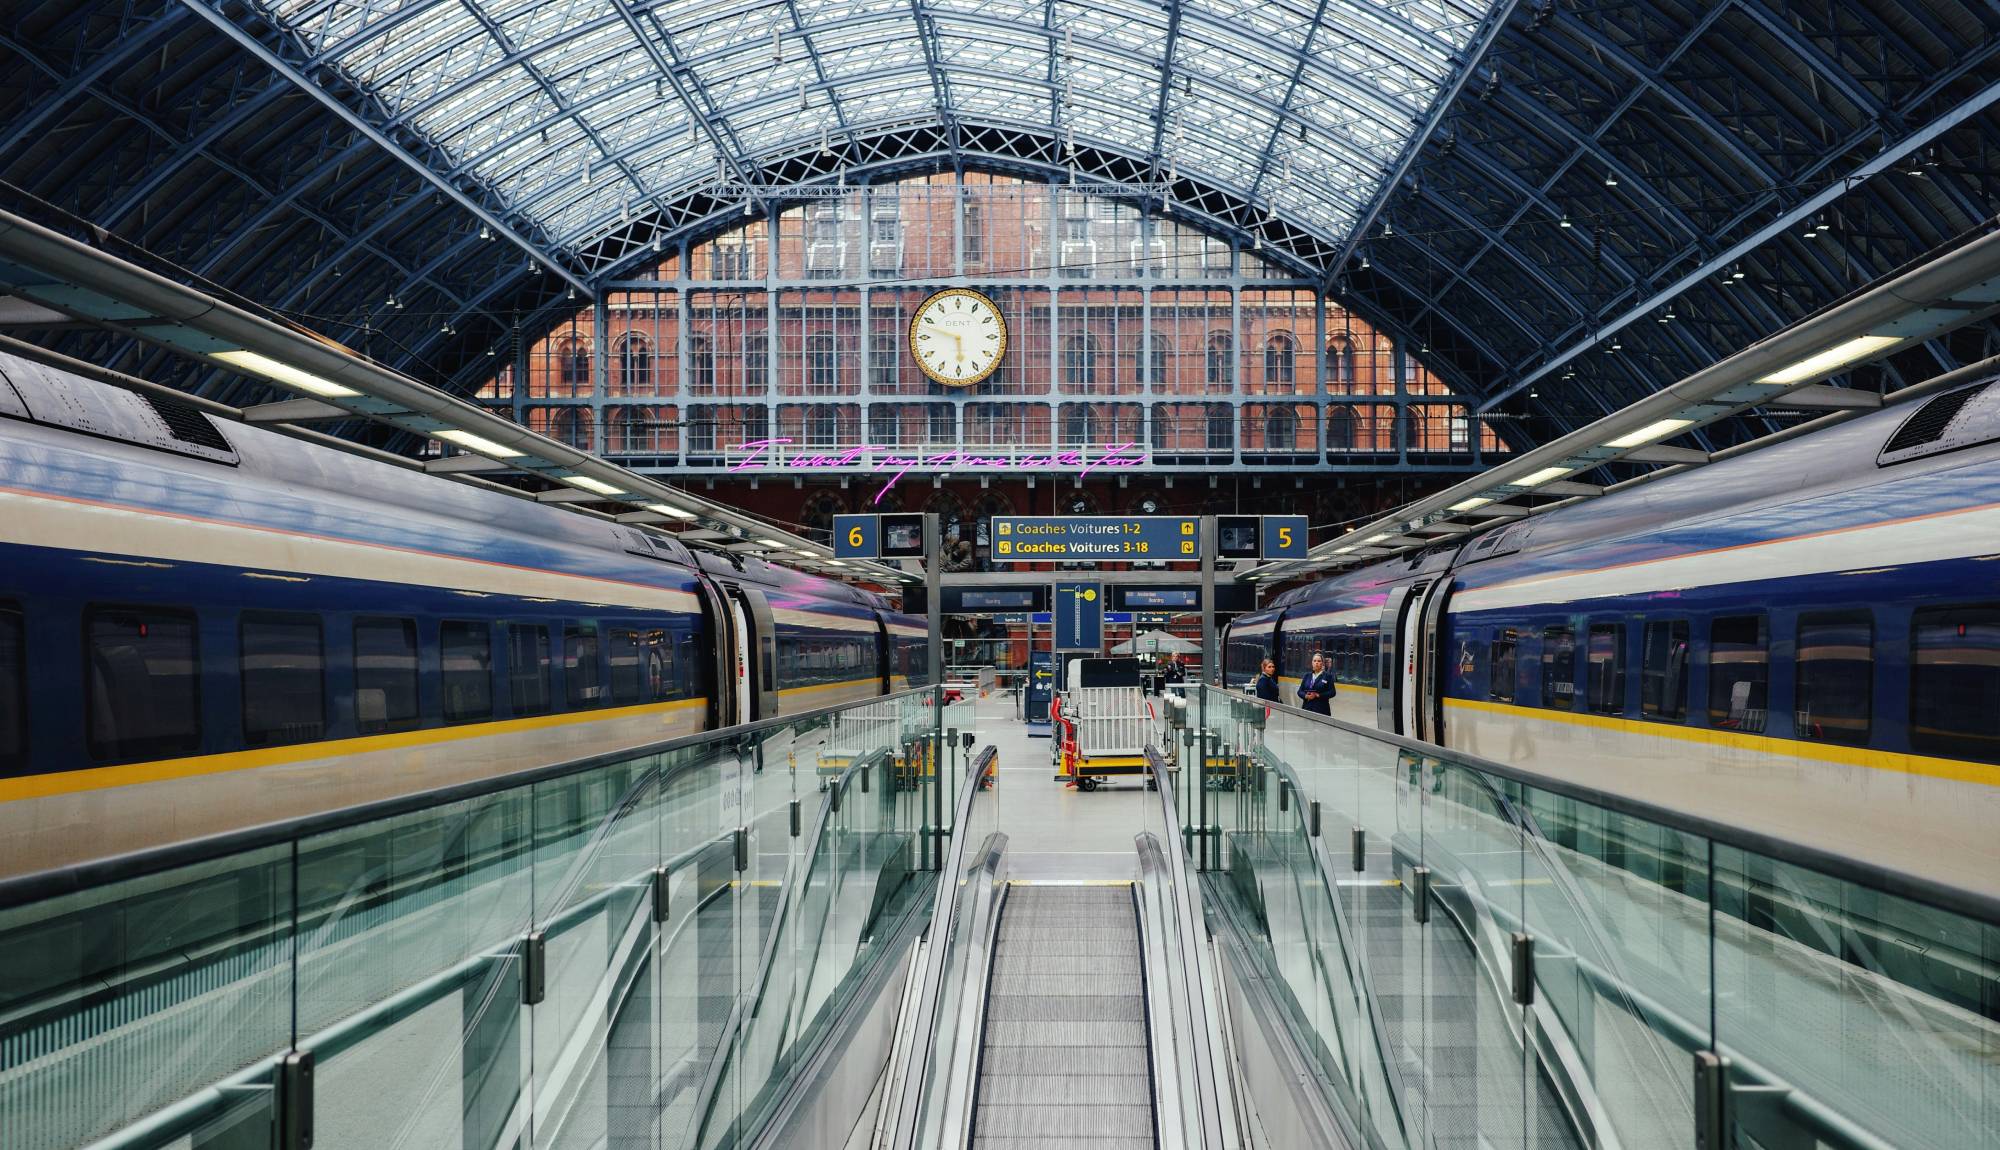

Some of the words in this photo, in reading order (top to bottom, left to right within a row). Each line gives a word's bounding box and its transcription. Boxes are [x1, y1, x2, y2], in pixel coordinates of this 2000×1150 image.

[728, 438, 793, 473] I
[848, 526, 864, 548] 6
[1016, 523, 1066, 534] Coaches
[1069, 523, 1120, 534] Voitures
[1122, 523, 1141, 534] 1-2
[1279, 527, 1292, 548] 5
[1016, 542, 1066, 553] Coaches
[1069, 542, 1120, 553] Voitures
[1123, 542, 1149, 553] 3-18
